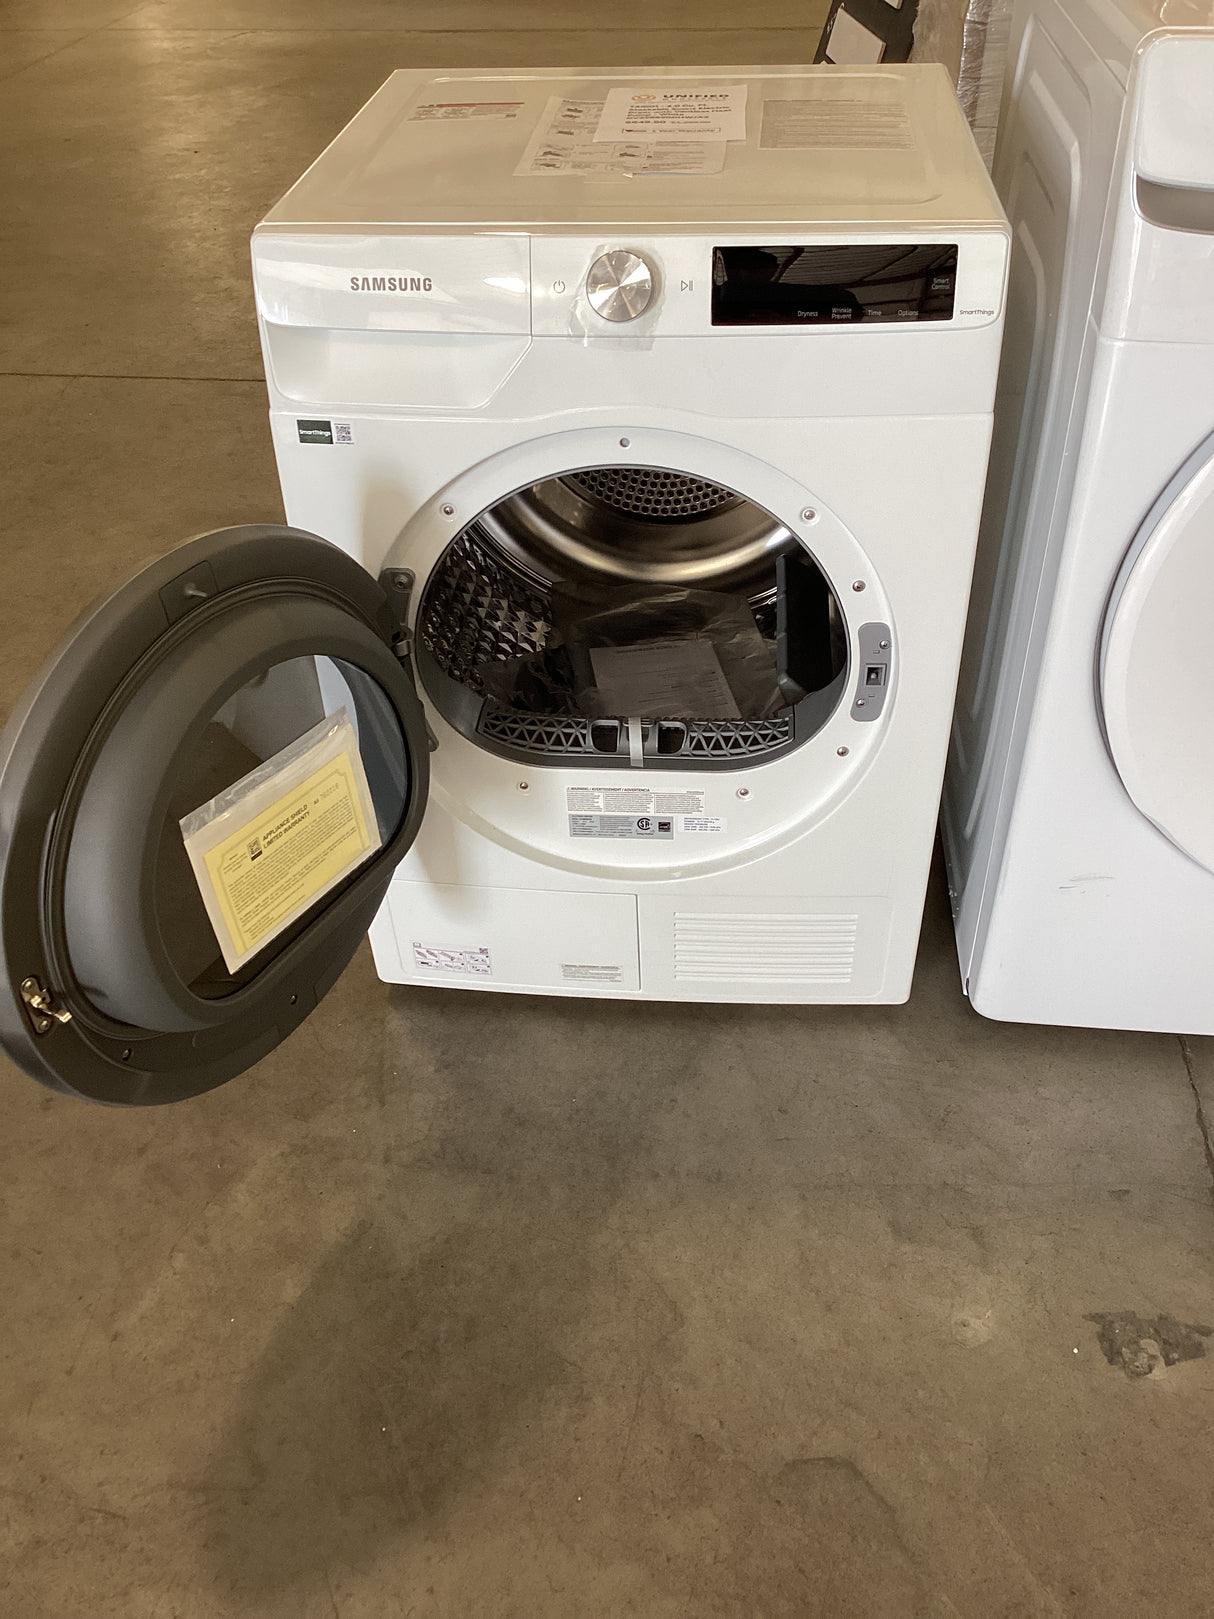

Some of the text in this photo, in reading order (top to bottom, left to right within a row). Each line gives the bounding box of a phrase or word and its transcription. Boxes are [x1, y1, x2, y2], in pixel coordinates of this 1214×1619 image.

[350, 277, 433, 292] SAMSUNG
[797, 310, 819, 318] Dryness
[831, 306, 852, 314] Wrinkle
[898, 309, 919, 318] Options
[959, 309, 995, 317] SmartThings
[262, 804, 308, 842] APPLIANCE SHIELD
[263, 831, 283, 849] LIMITED
[283, 811, 310, 834] WARRANTY
